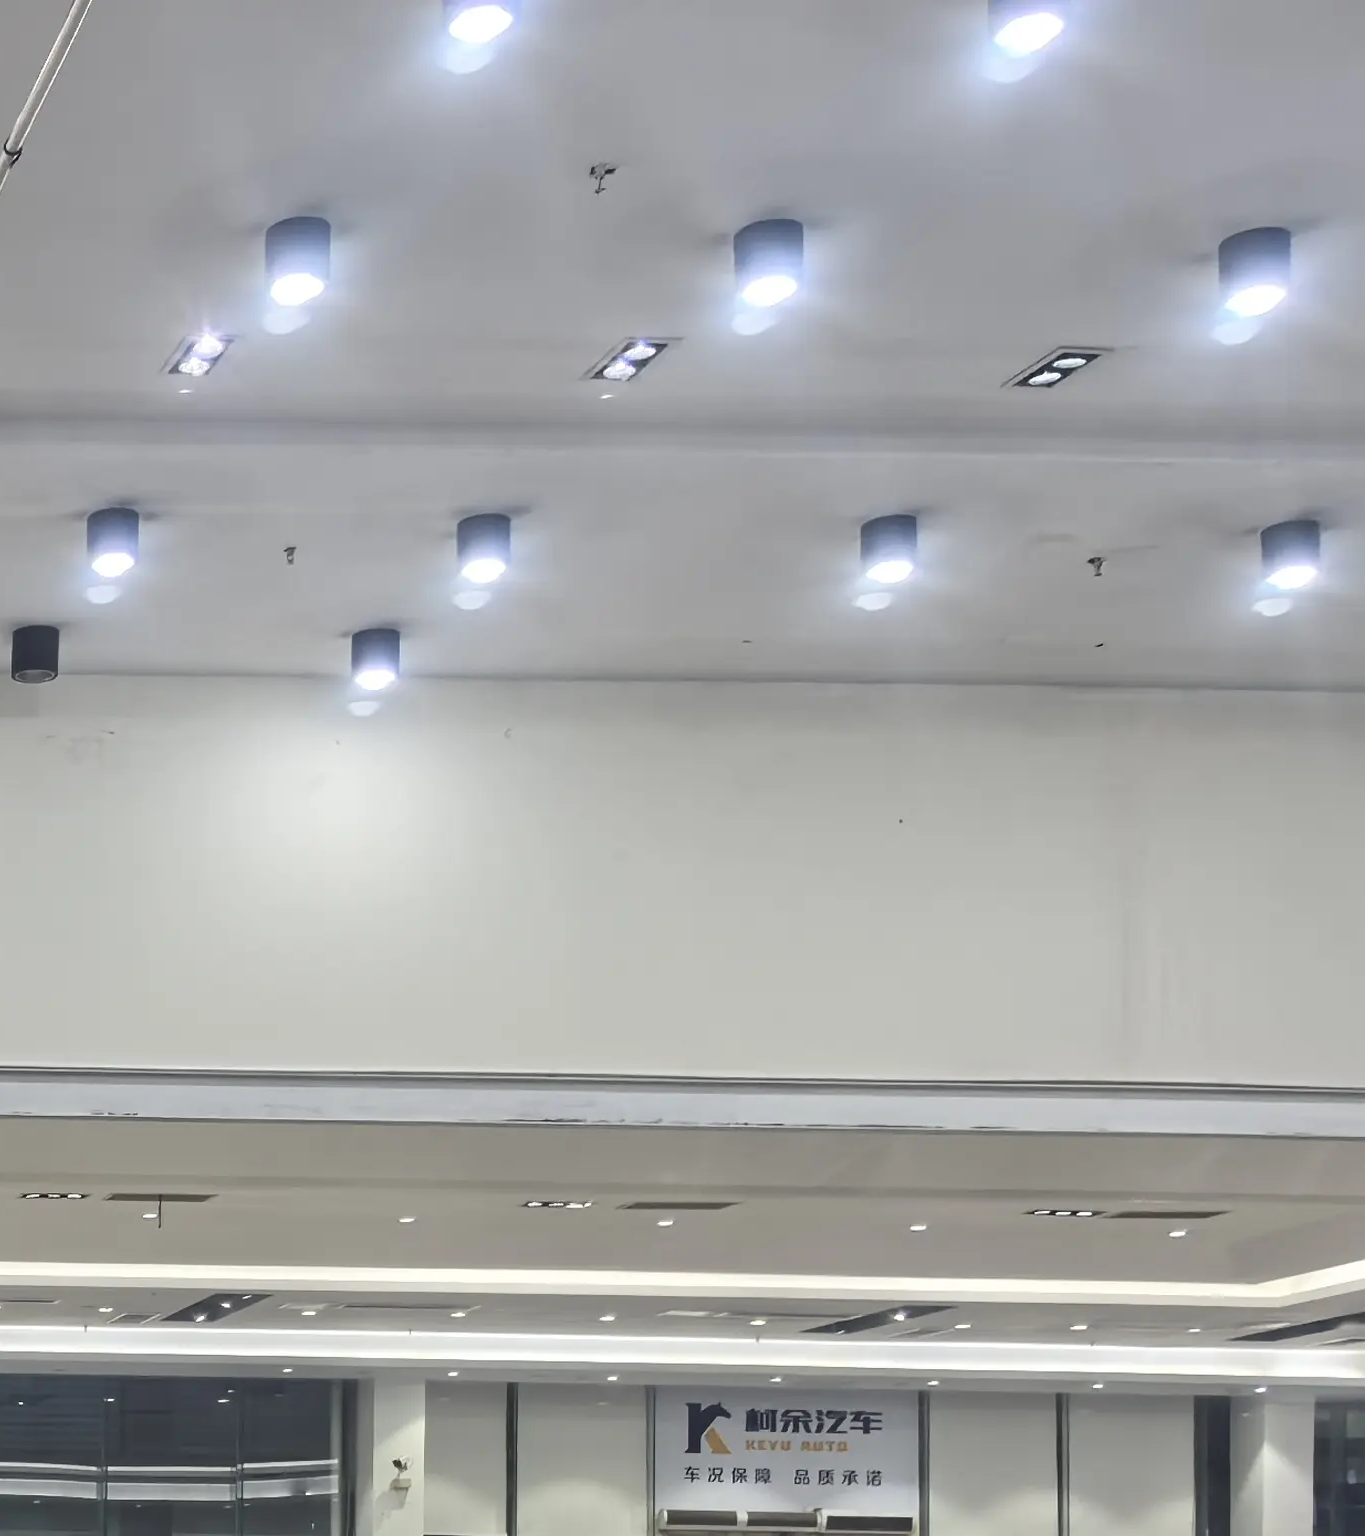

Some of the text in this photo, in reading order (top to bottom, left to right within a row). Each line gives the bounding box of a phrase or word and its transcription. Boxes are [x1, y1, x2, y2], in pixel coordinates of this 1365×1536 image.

[744, 1408, 883, 1434] 柯余汽车
[683, 1466, 883, 1486] 车况保障 品质承诺
